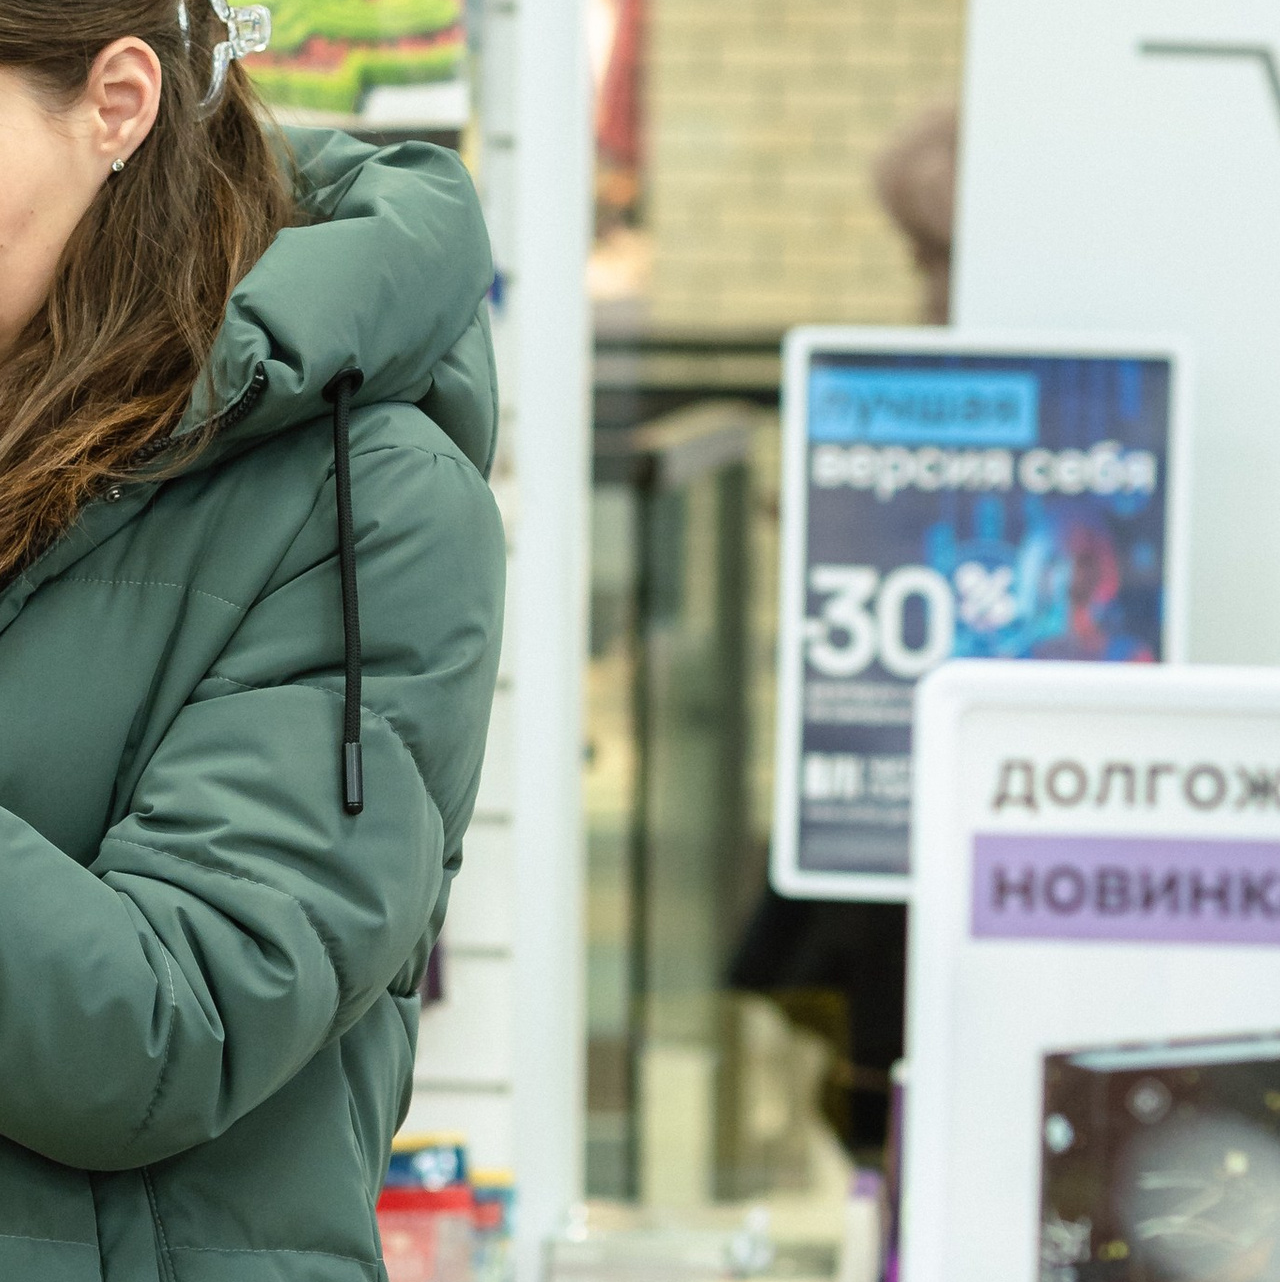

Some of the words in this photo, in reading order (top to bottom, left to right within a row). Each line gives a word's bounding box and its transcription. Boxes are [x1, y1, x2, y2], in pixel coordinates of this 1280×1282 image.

[812, 445, 1014, 503] версия
[1019, 439, 1157, 495] себя
[991, 759, 1280, 814] ДОЛГОЖ
[989, 863, 1280, 920] НОВИНК
